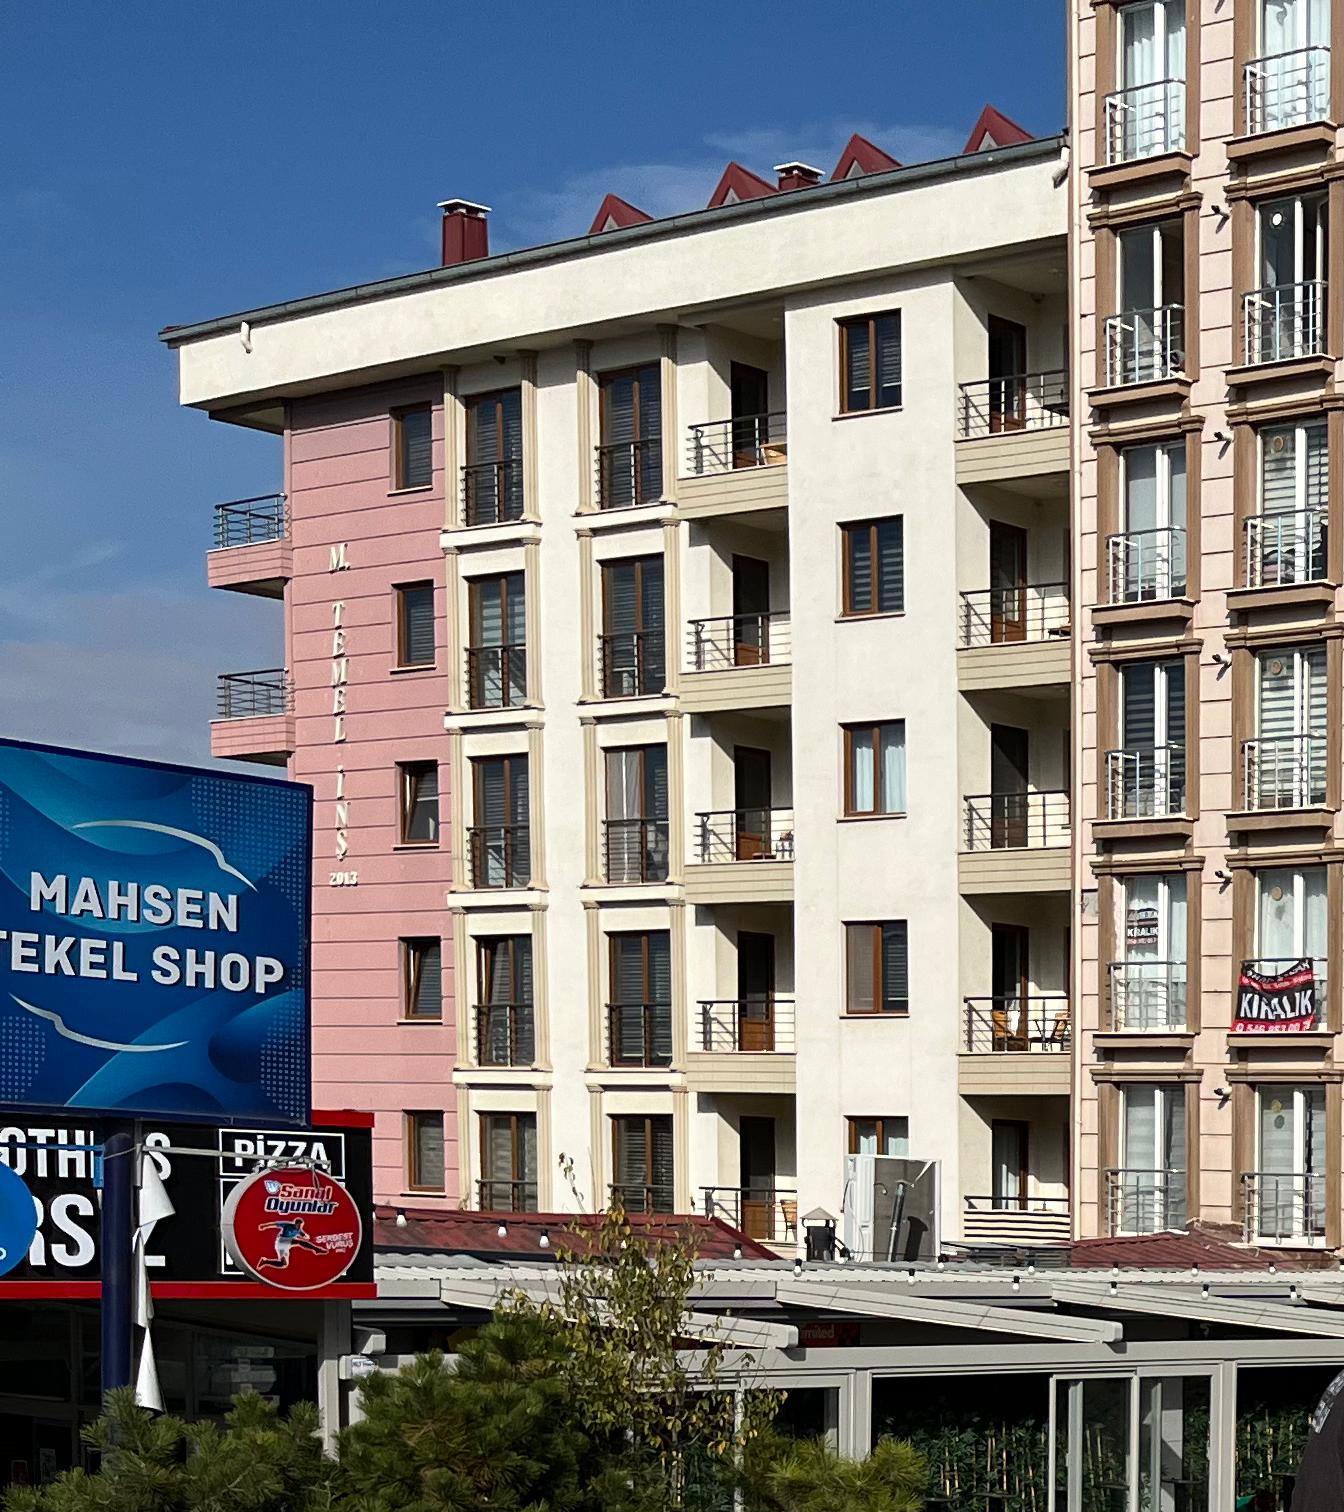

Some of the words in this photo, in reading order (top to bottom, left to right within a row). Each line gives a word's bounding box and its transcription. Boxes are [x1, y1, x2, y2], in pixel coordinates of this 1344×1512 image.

[331, 600, 350, 745] TEMEL
[329, 870, 358, 887] 2013
[30, 871, 238, 933] MAHSEN
[151, 945, 285, 994] SHOP
[234, 1134, 329, 1171] PİZZA
[265, 1196, 340, 1215] Oyunlar
